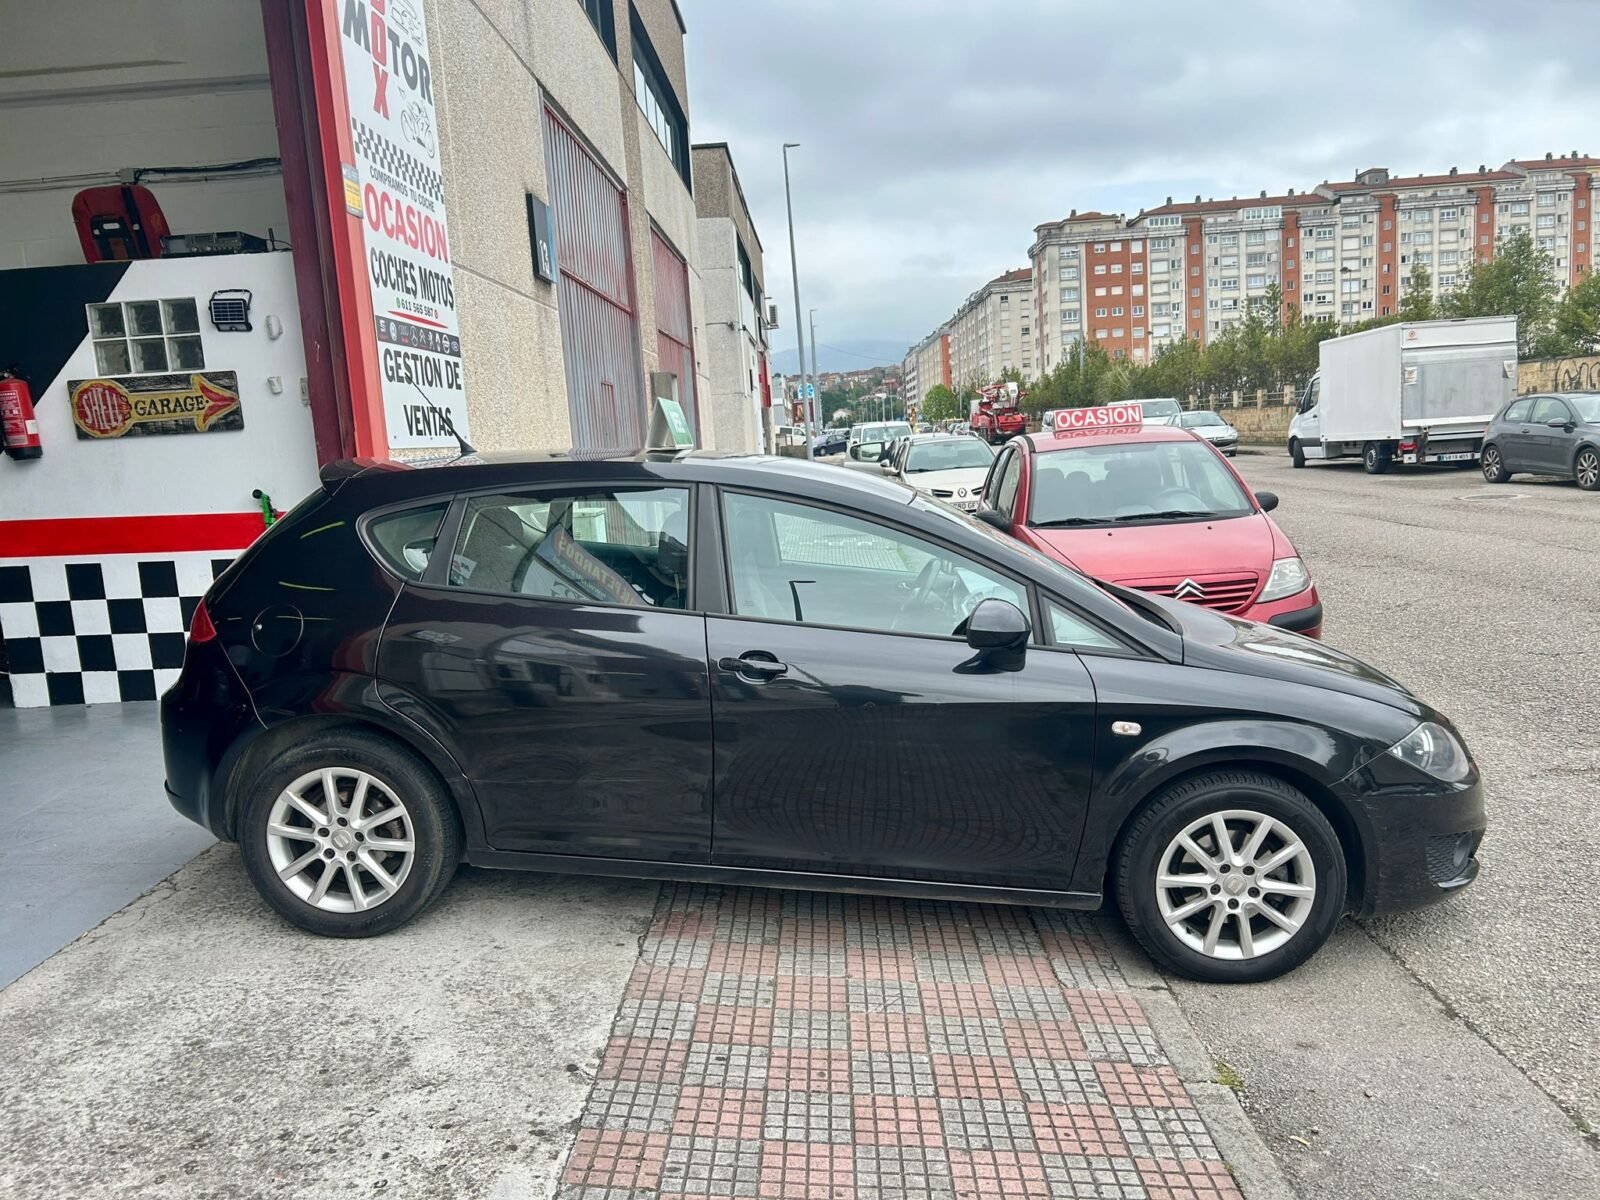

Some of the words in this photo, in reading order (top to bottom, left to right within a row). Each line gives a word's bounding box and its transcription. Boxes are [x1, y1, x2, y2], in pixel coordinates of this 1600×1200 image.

[370, 0, 389, 120] OX
[369, 165, 409, 197] COMPRAMOS
[410, 188, 417, 202] TU
[364, 183, 448, 263] OCASION
[370, 246, 417, 299] COCHES
[418, 266, 454, 311] MOTOS
[401, 299, 412, 311] 611
[383, 348, 443, 388] GESTION
[445, 359, 462, 390] DE
[82, 387, 123, 430] SHELL
[134, 395, 206, 416] GARAGE
[403, 404, 454, 437] VENTAS
[1057, 406, 1140, 428] OCASION
